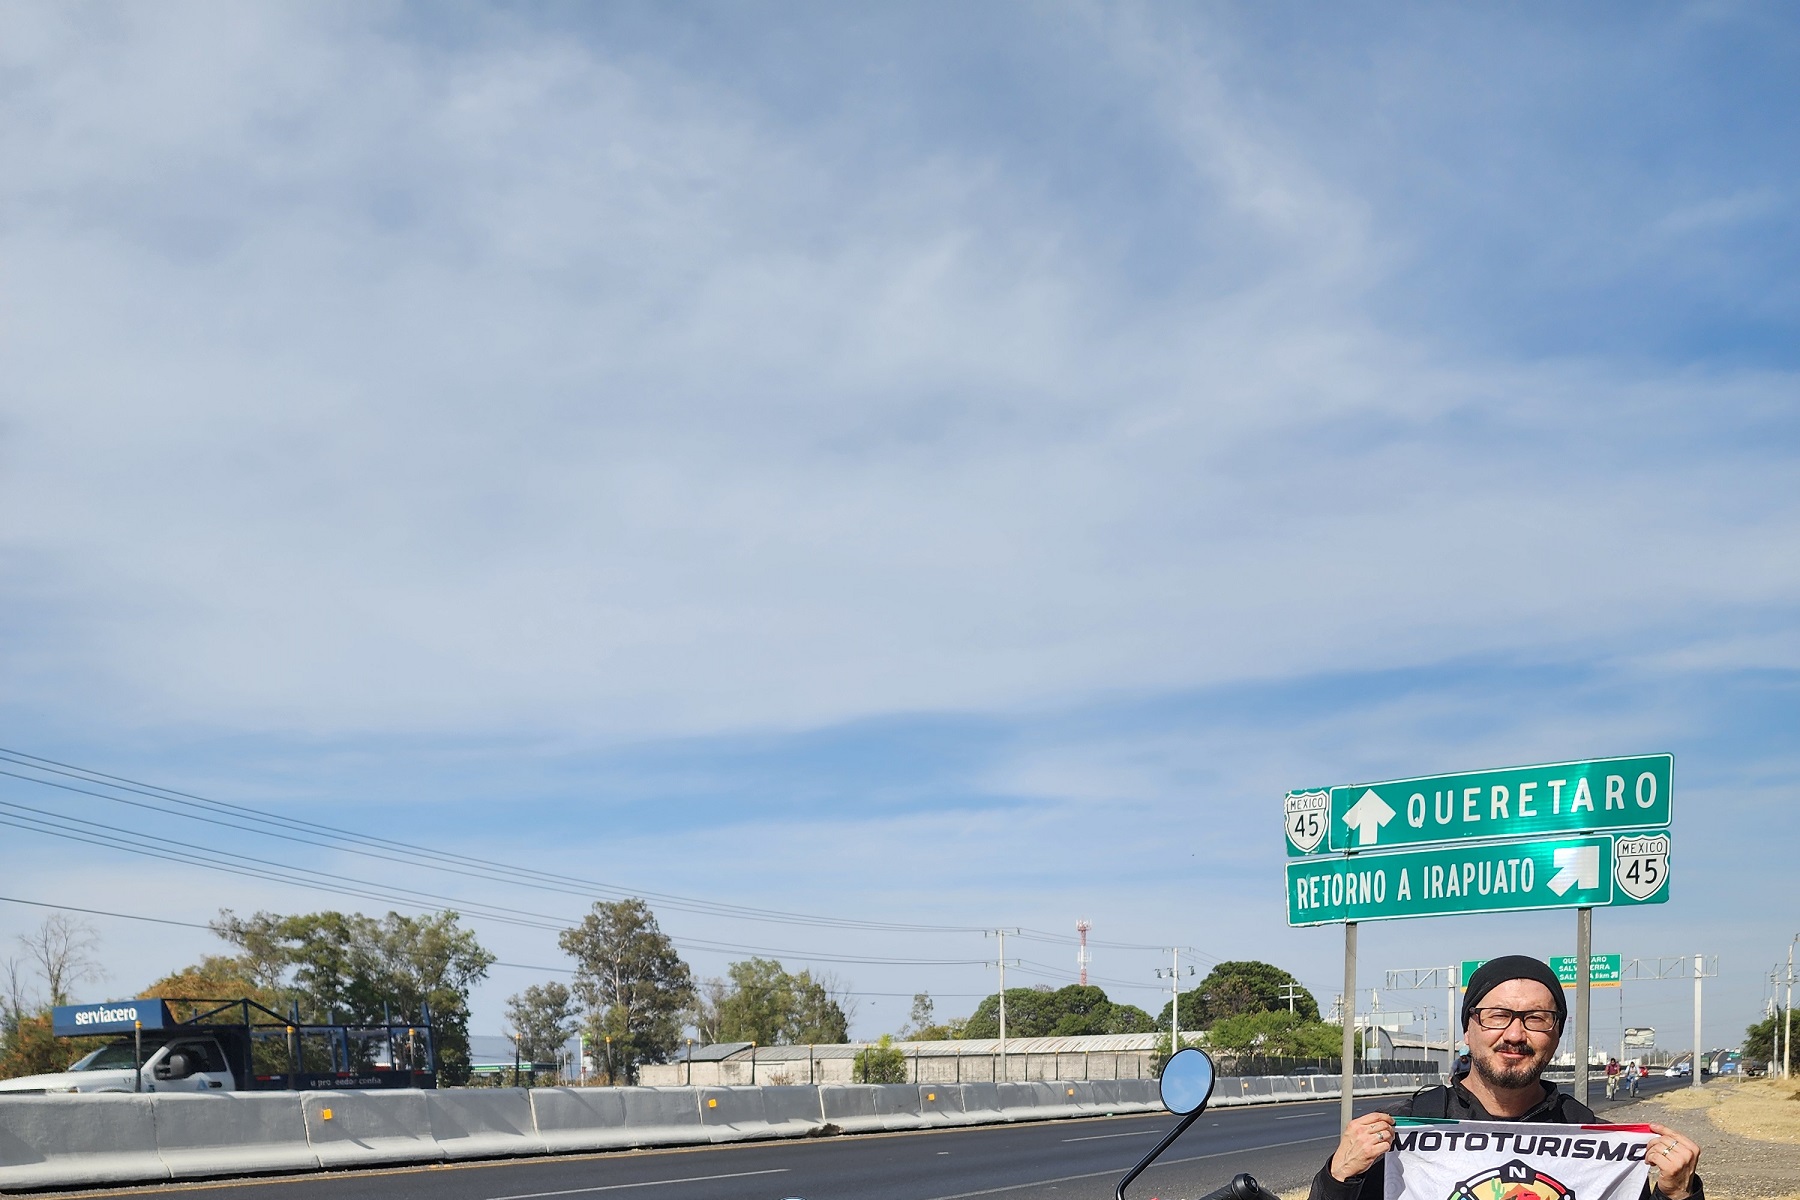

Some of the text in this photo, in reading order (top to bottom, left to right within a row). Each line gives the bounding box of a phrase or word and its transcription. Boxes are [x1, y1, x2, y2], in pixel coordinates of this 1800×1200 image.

[1290, 797, 1323, 811] MEXICO
[1407, 771, 1657, 828] QUERETARO
[1294, 813, 1319, 838] 45
[1621, 841, 1663, 854] MEXICO
[1625, 858, 1658, 885] 45
[1297, 857, 1535, 910] RETORNO A IRAPUATO
[1558, 964, 1611, 972] SALVERRA
[1562, 956, 1607, 964] QUEARO
[75, 1005, 138, 1026] serviacero
[1388, 1131, 1648, 1162] MOTOTURISMO
[1508, 1166, 1527, 1179] N
